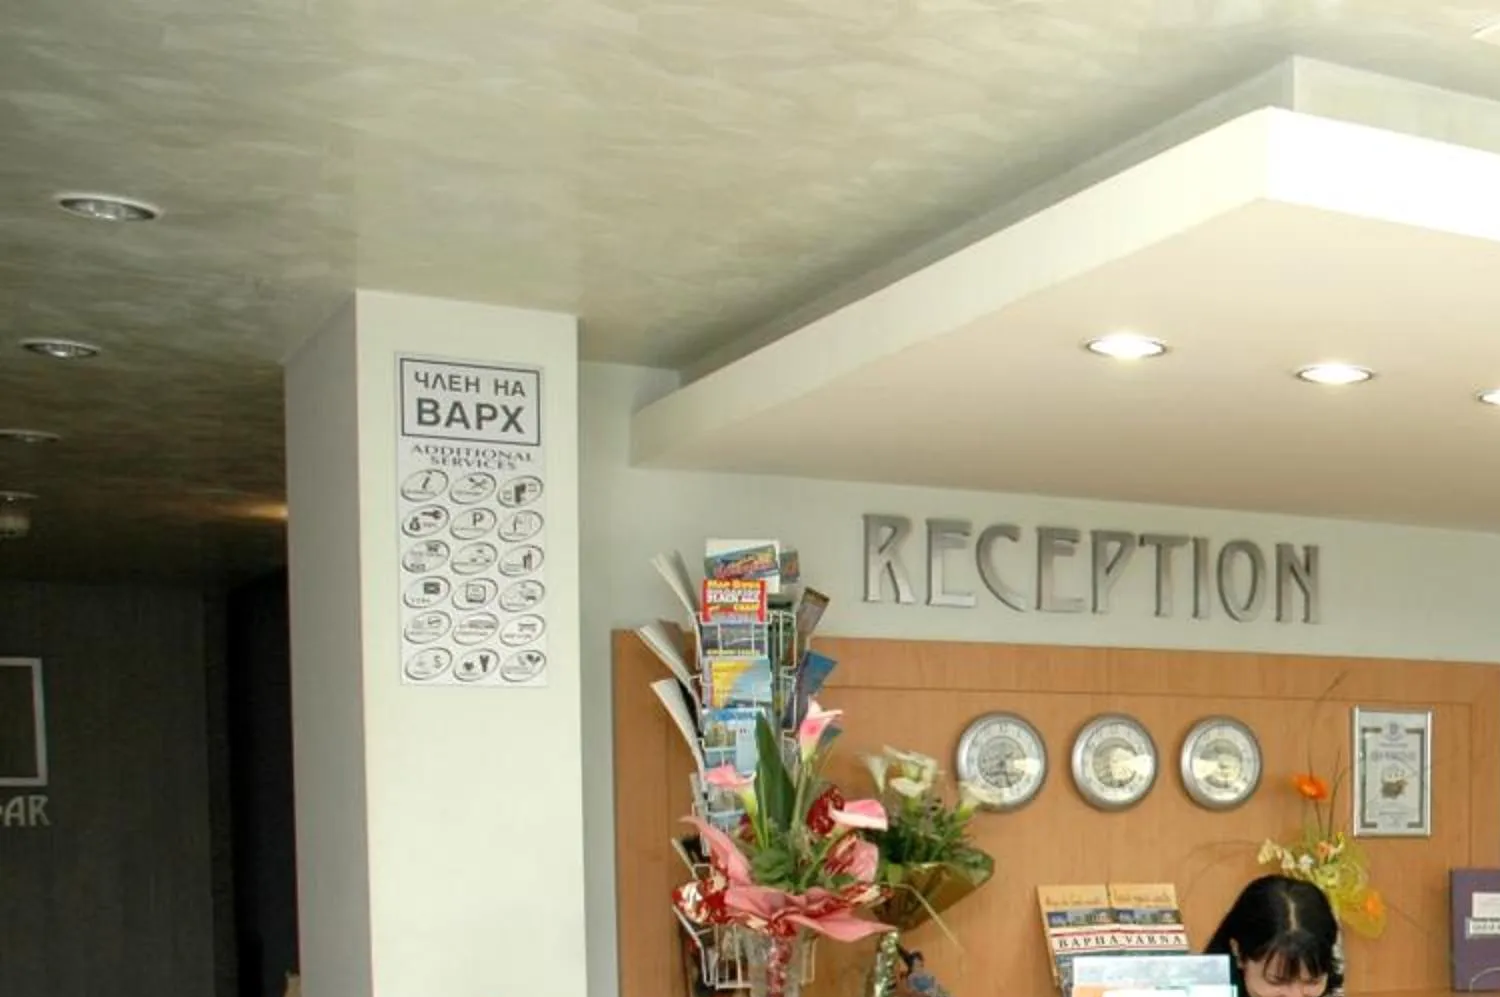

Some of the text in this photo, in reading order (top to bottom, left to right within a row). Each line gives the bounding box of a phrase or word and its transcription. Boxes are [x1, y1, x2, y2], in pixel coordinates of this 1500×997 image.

[414, 370, 526, 397] ЧЛЕН НА
[416, 397, 525, 434] ВАРХ
[411, 444, 532, 462] ADDITIONAL
[861, 513, 1322, 624] RECEPTION
[0, 795, 51, 827] AR
